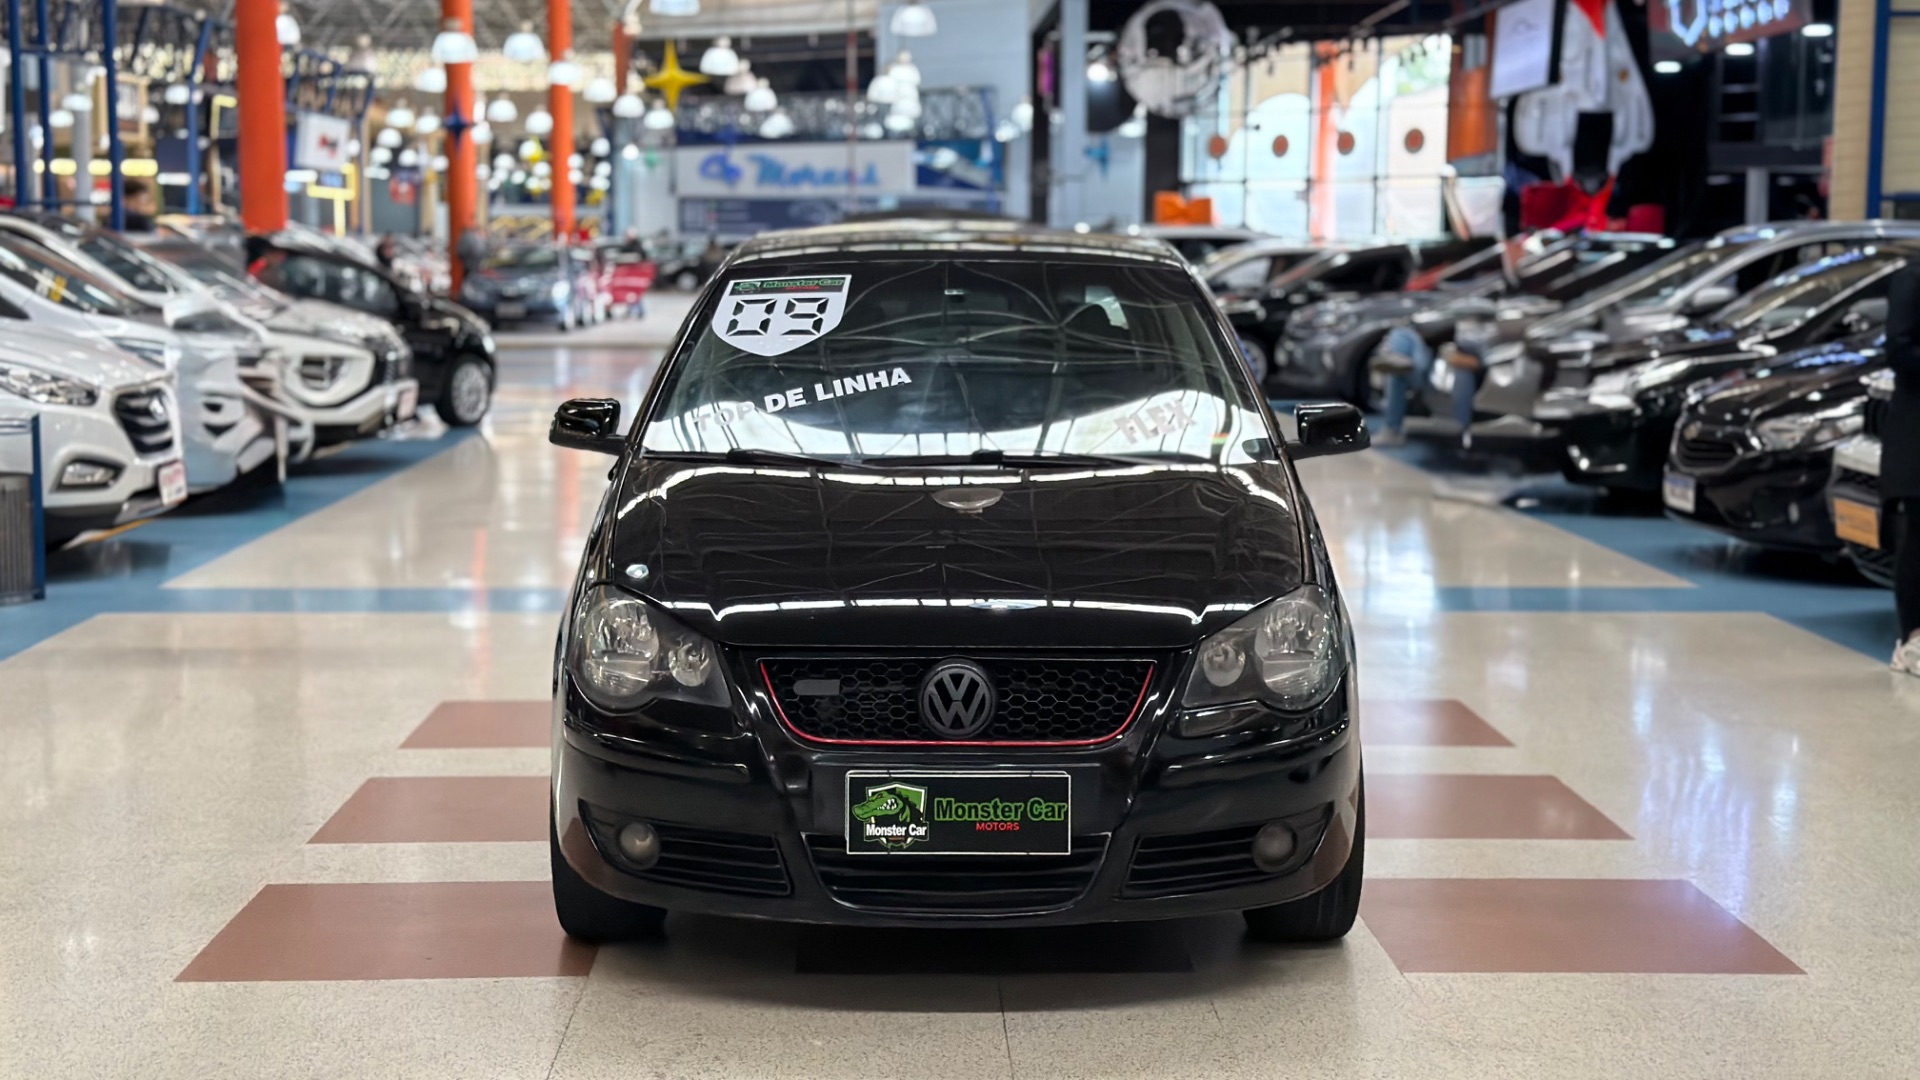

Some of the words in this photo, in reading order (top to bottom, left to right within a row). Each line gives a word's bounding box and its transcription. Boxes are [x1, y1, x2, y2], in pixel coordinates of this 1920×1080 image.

[763, 280, 819, 289] Monster
[819, 278, 845, 287] Car
[726, 297, 829, 336] 09
[693, 401, 755, 432] TOP
[764, 387, 806, 413] DE
[814, 367, 912, 401] LINHA
[1113, 400, 1197, 444] FLEX
[934, 797, 1024, 821] Monster
[1027, 797, 1067, 821] Car
[866, 824, 907, 836] Monster
[908, 823, 927, 836] Car
[976, 822, 1020, 831] MOTORS
